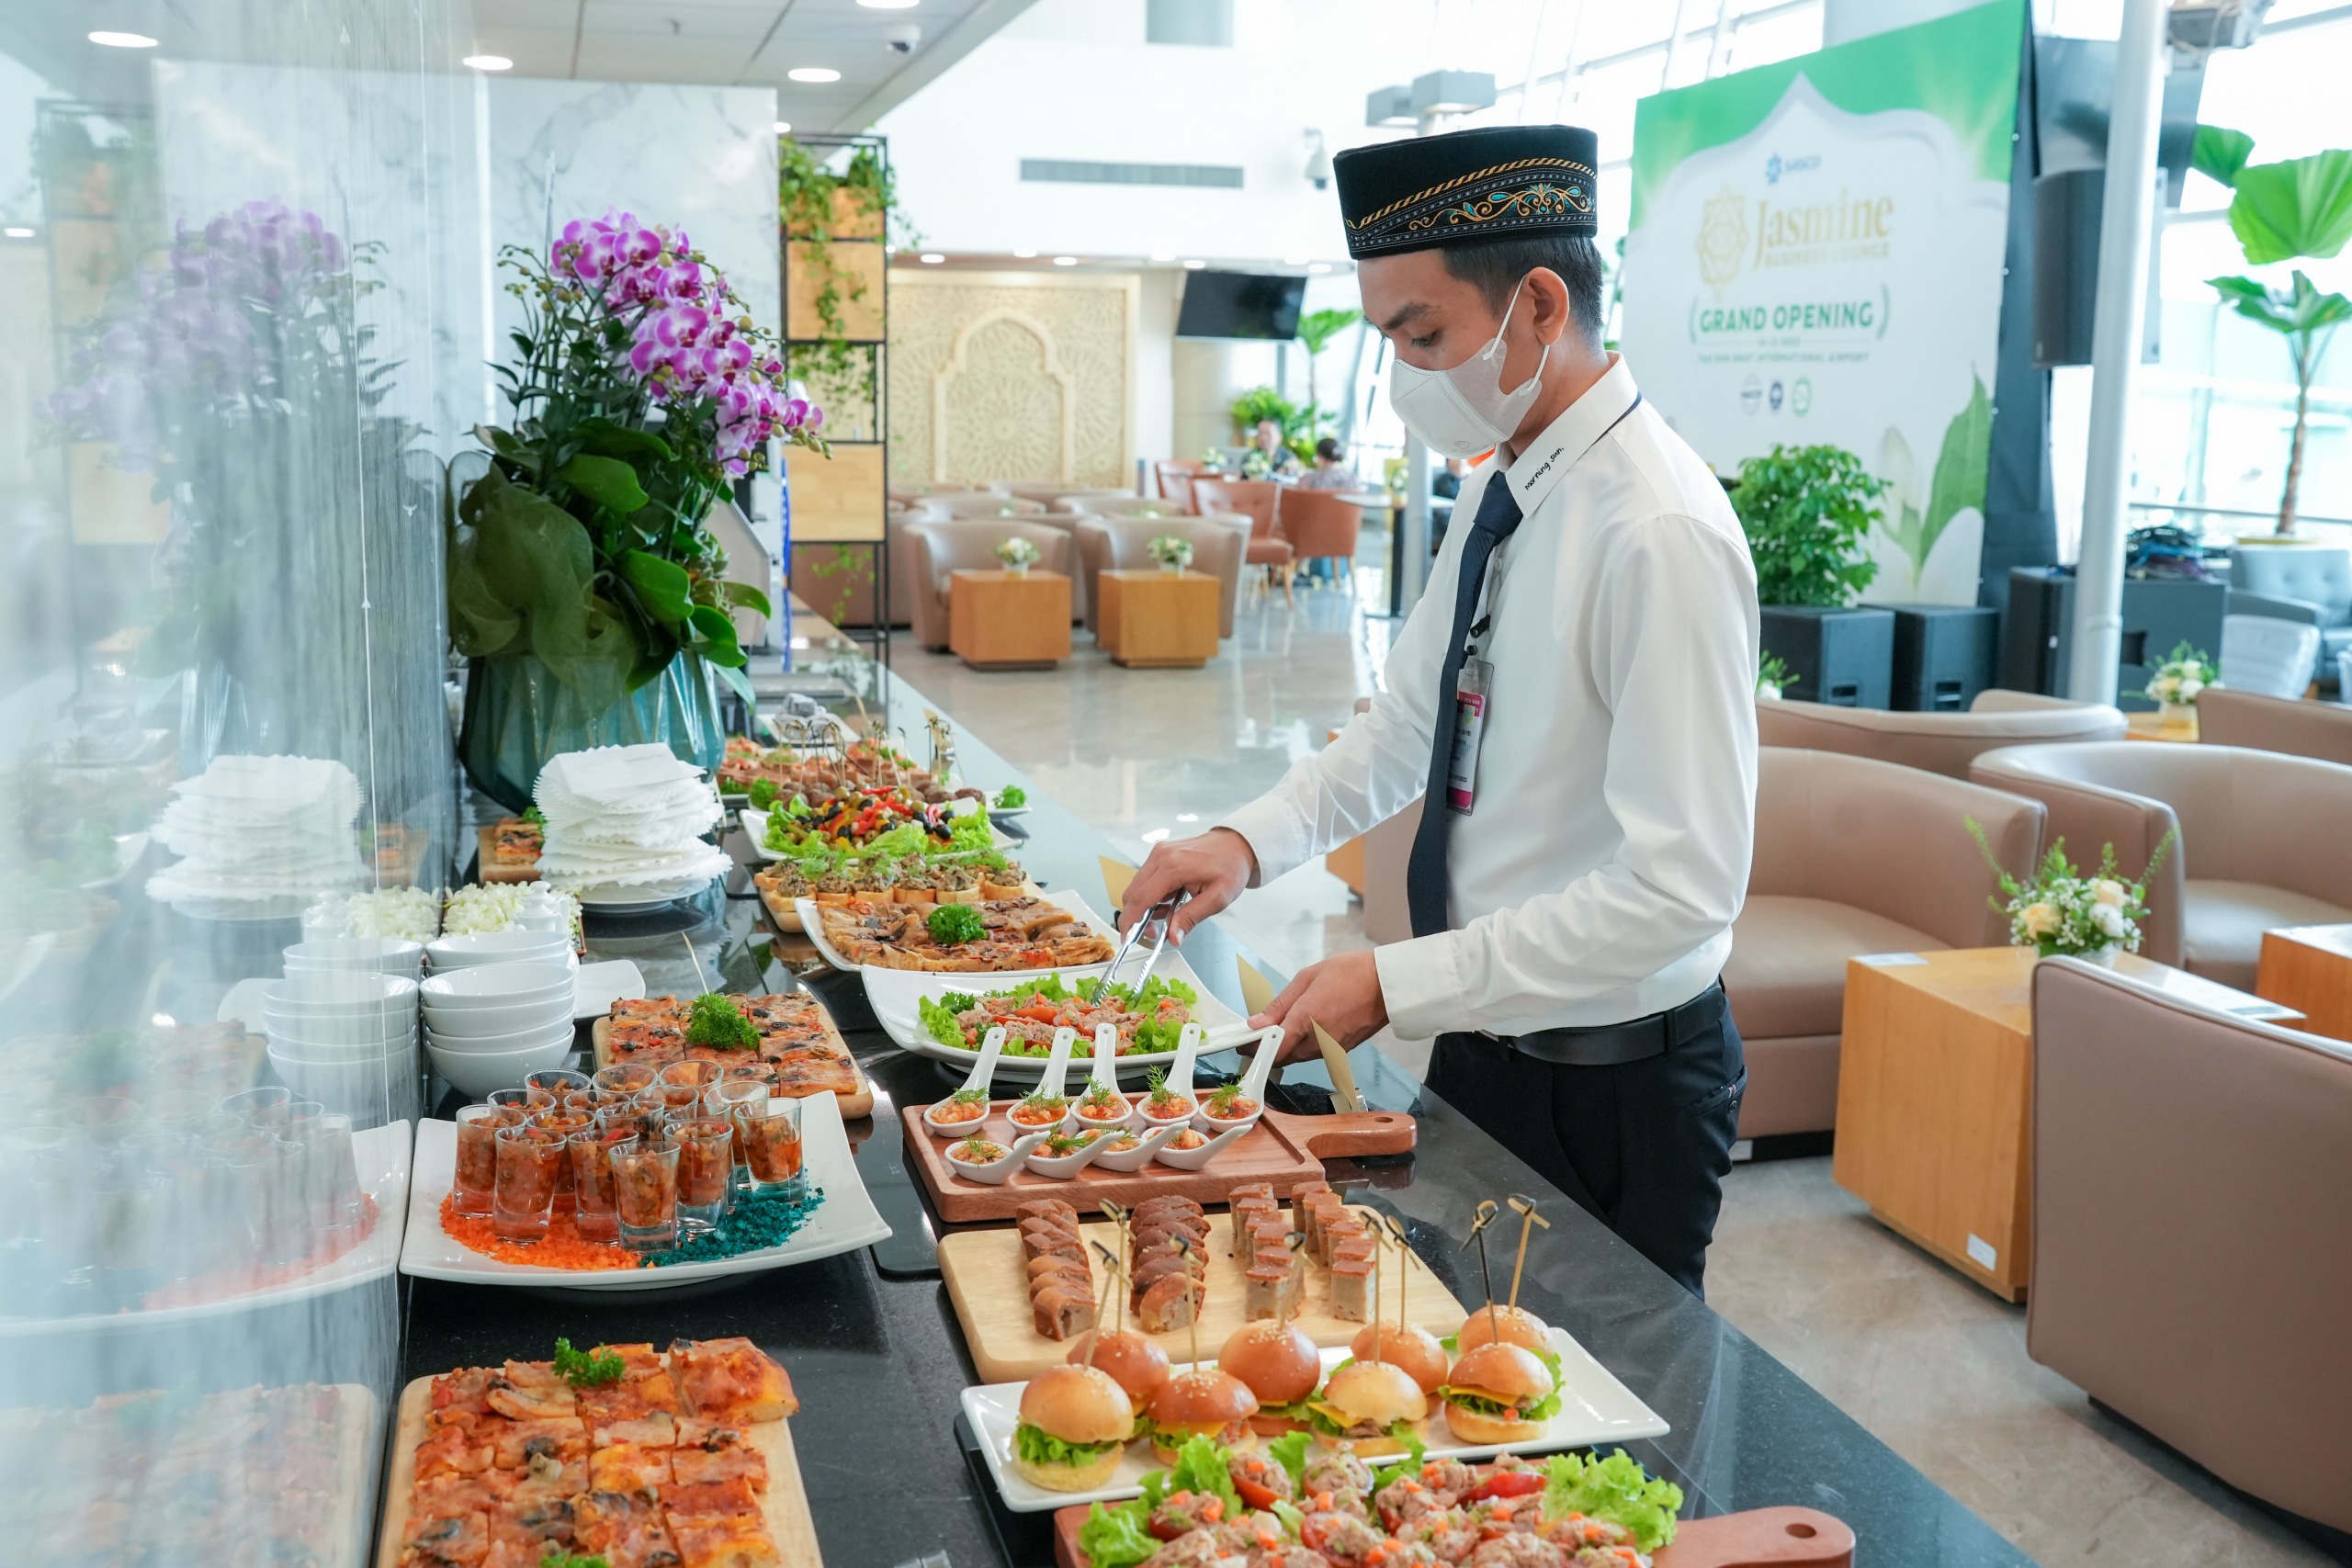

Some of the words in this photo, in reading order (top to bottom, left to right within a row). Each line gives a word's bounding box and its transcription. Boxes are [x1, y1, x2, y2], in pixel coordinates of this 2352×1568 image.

[1754, 187, 1894, 268] Jasmine
[1700, 307, 1767, 333] GRAND
[1773, 301, 1874, 330] OPENING
